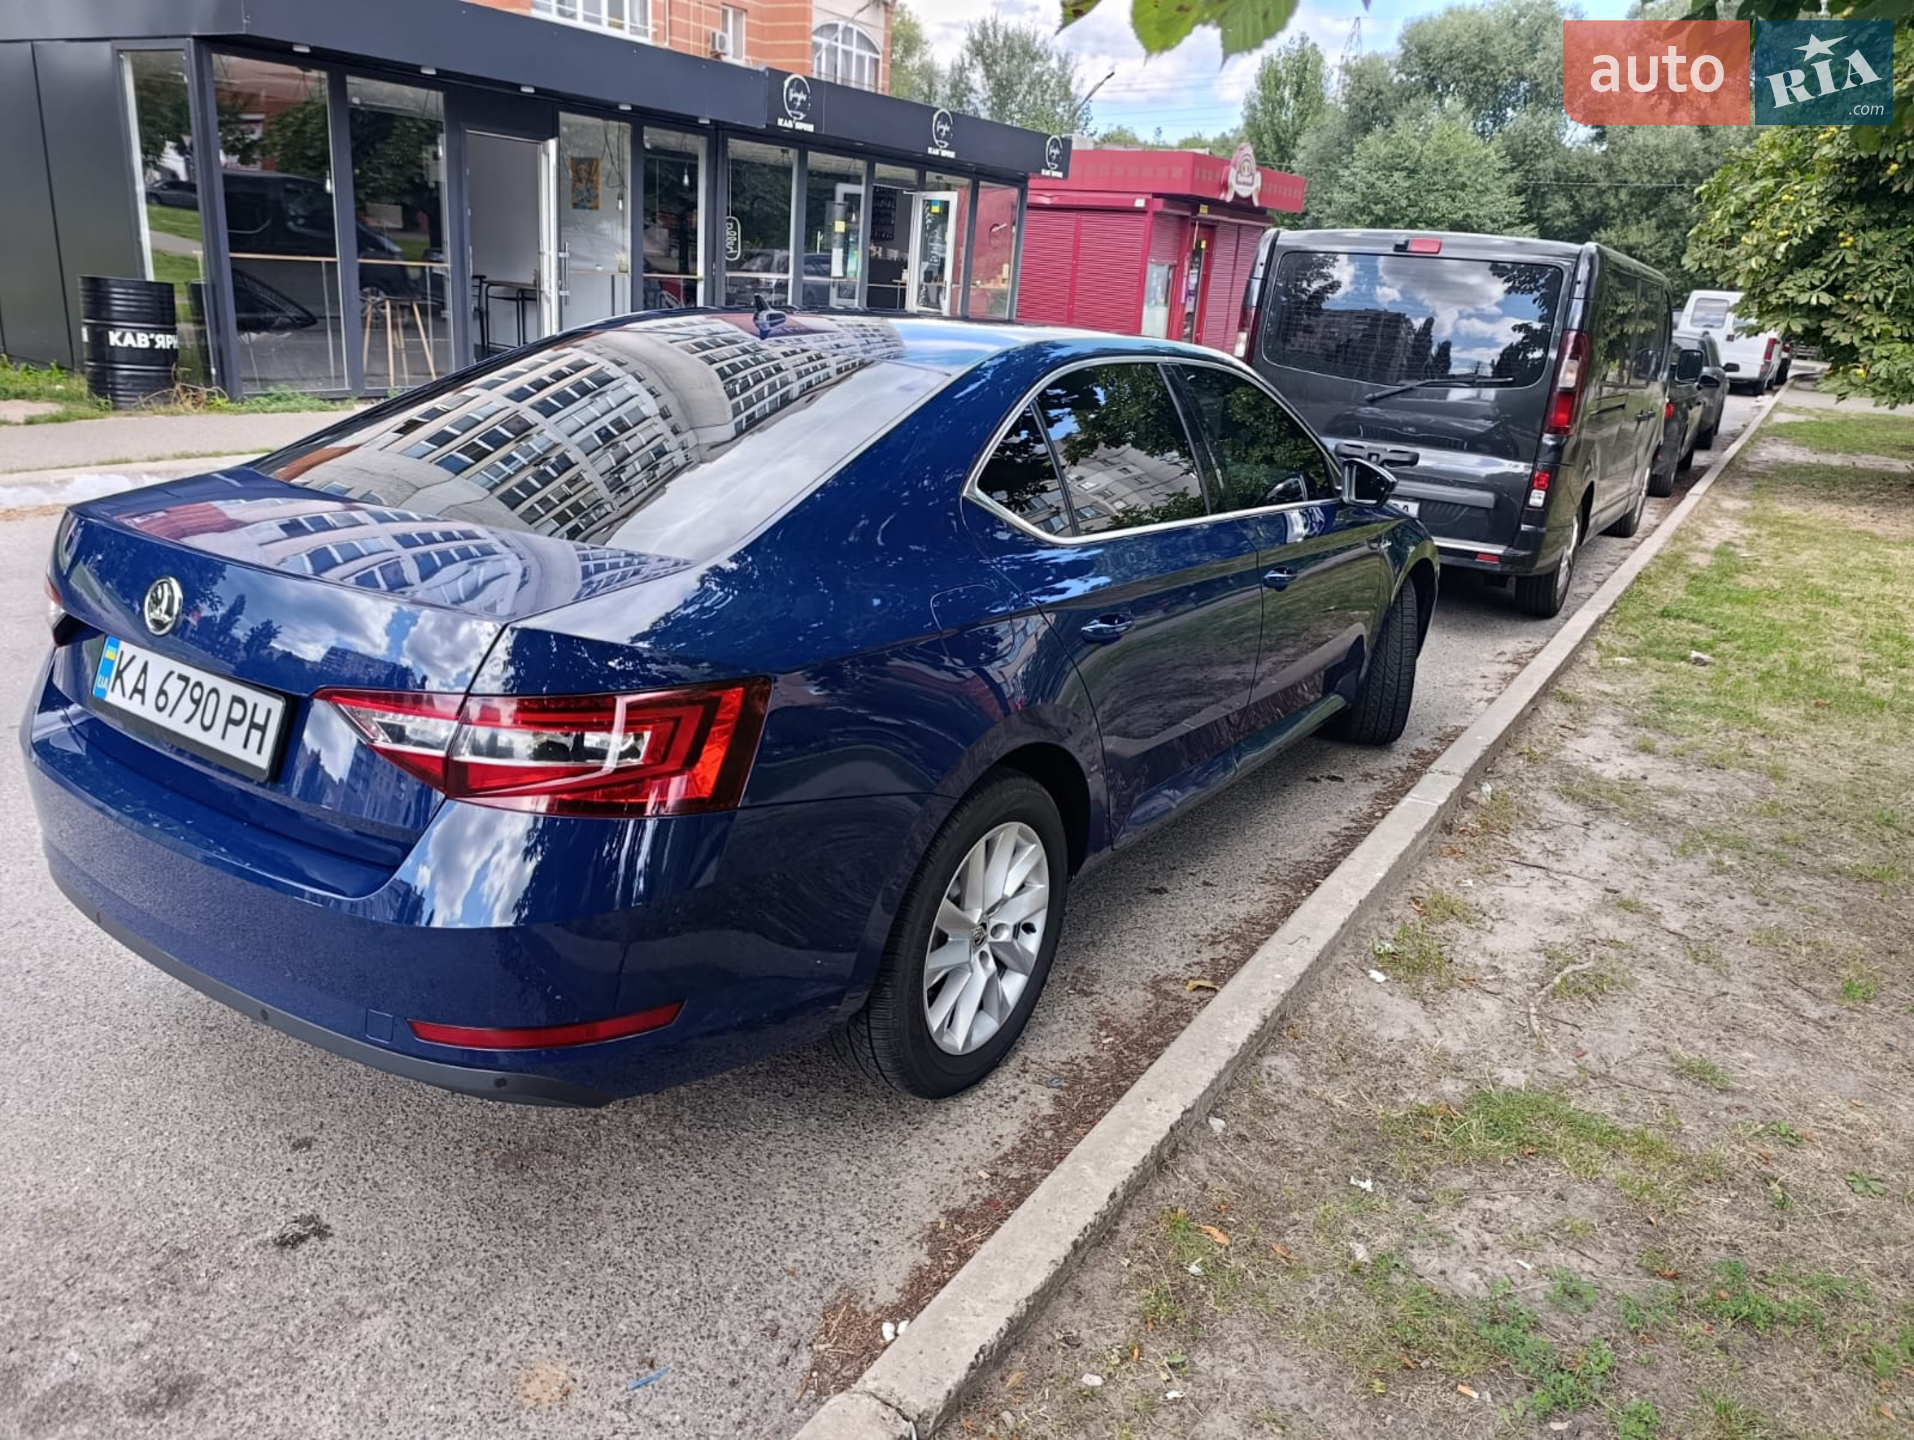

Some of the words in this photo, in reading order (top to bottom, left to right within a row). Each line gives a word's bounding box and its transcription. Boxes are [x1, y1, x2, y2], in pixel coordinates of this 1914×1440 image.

[97, 675, 109, 690] UA
[111, 650, 149, 706] KA
[154, 670, 220, 732] 6790
[221, 694, 272, 755] PH
